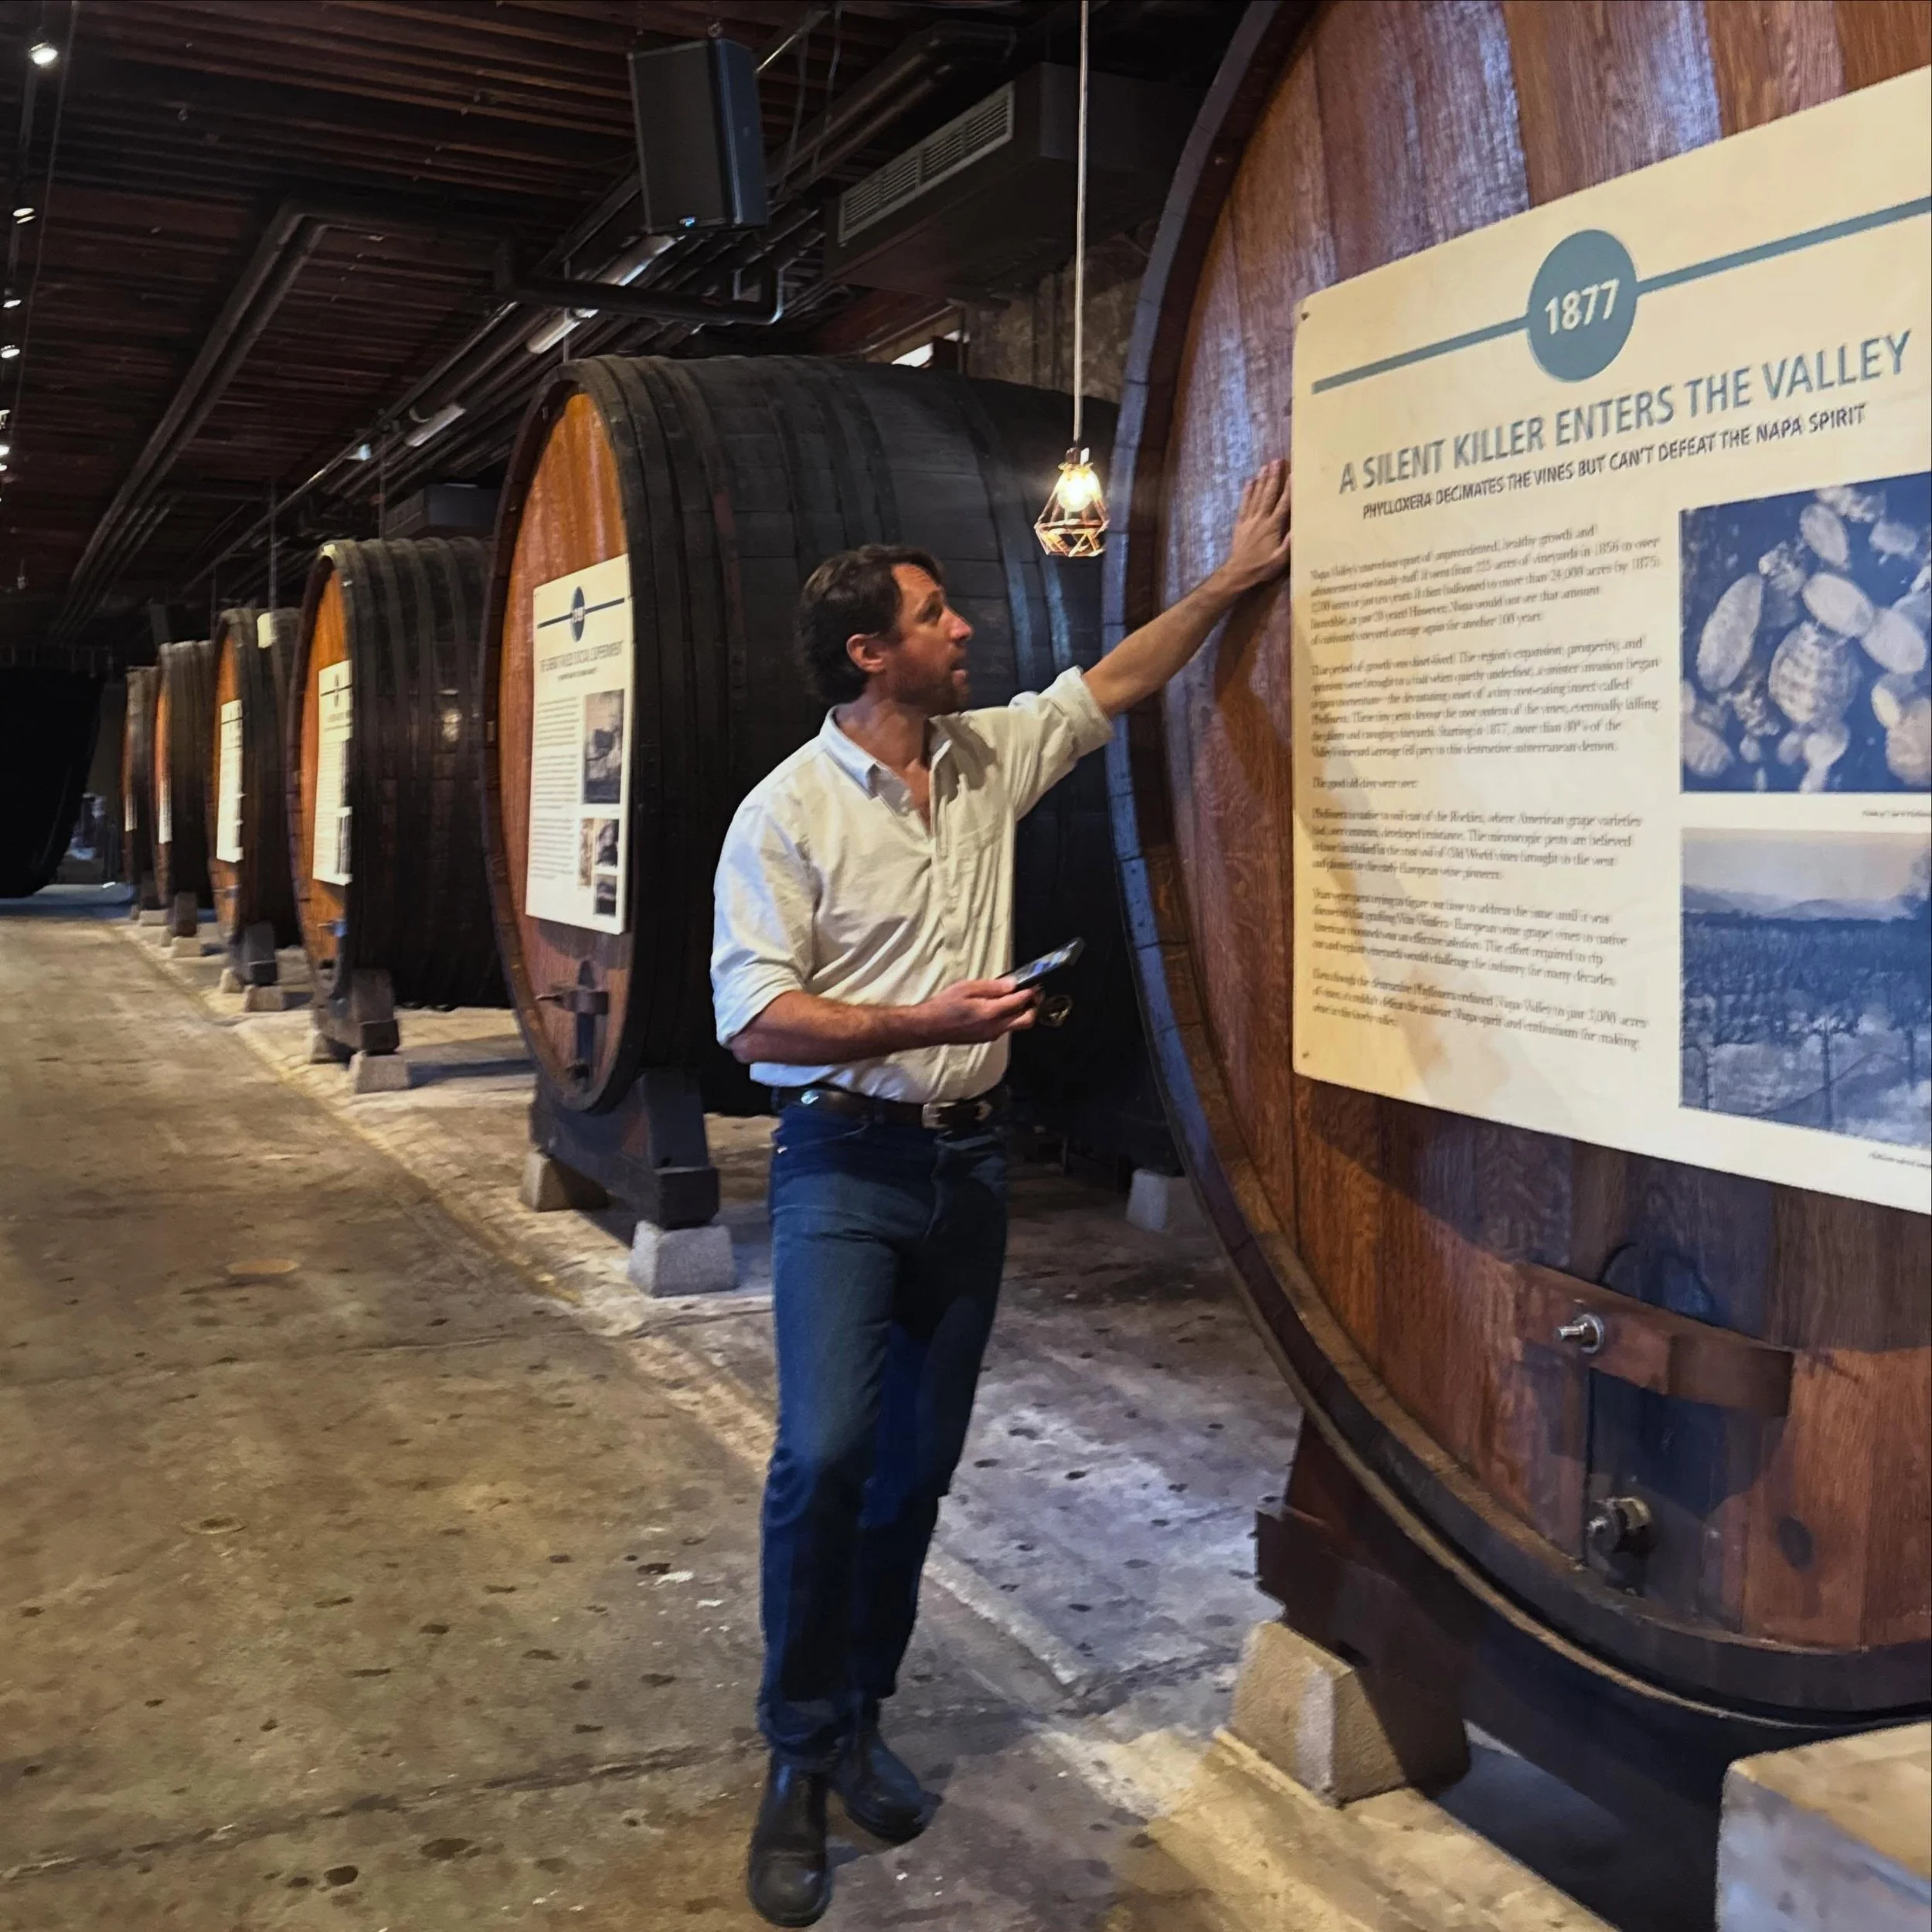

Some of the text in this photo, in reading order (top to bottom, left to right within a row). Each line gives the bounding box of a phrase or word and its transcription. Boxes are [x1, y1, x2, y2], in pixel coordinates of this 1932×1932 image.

[1546, 277, 1620, 336] 1877
[1338, 329, 1913, 495] A SILENT KILLER ENTERS THE VALLEY
[1362, 403, 1867, 519] PHYLLOXERA DECIMATES THE VINES BUT CAN'T DEFEAT THE NAPA SPIRIT
